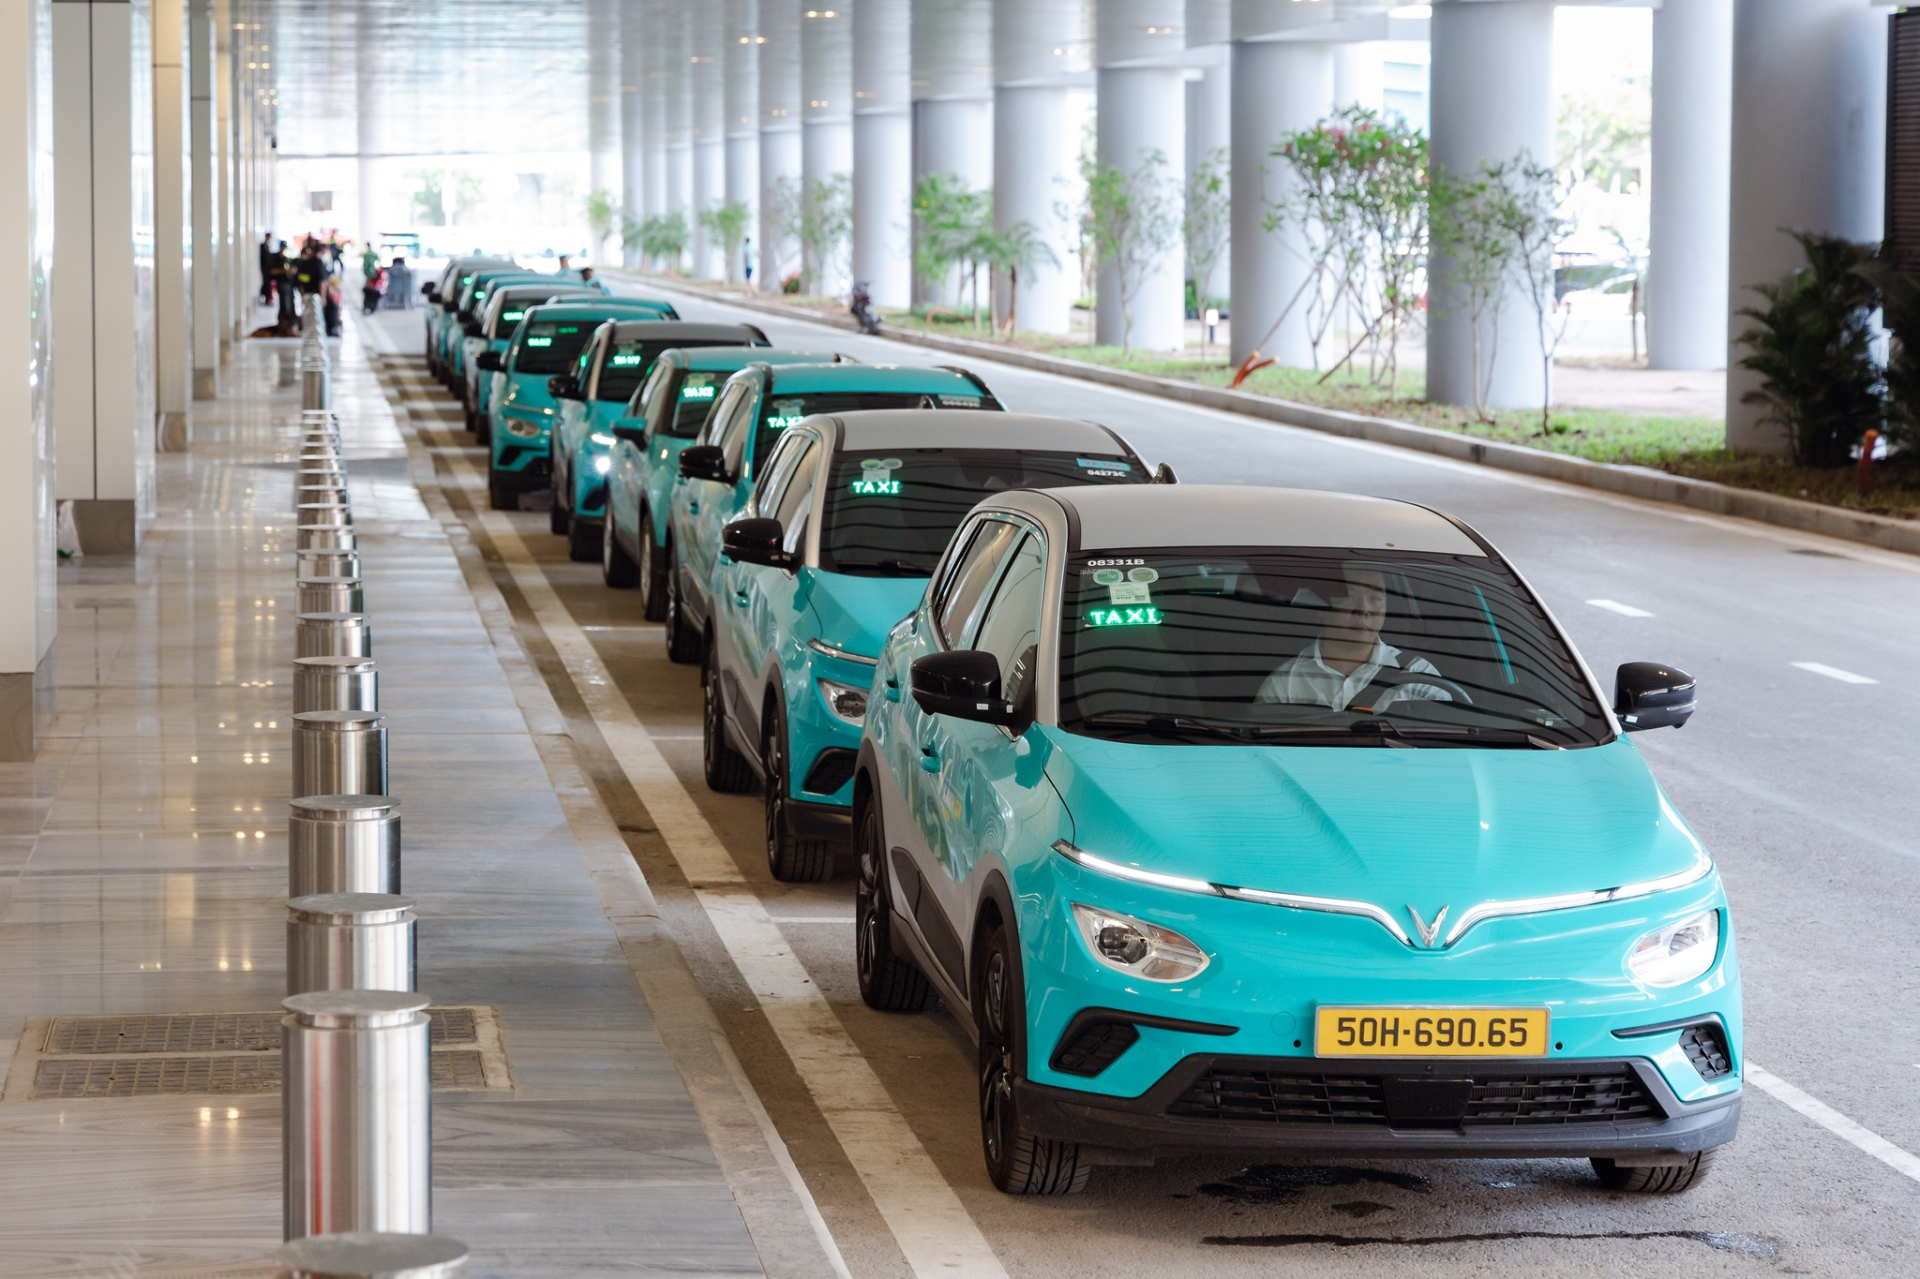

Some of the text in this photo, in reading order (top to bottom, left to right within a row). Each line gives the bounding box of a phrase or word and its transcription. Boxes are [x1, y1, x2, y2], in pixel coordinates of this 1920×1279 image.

[852, 480, 900, 495] TAXI
[1087, 559, 1145, 567] 08331B
[1090, 608, 1157, 625] TAXI
[1338, 1017, 1528, 1047] 50H-690.65
